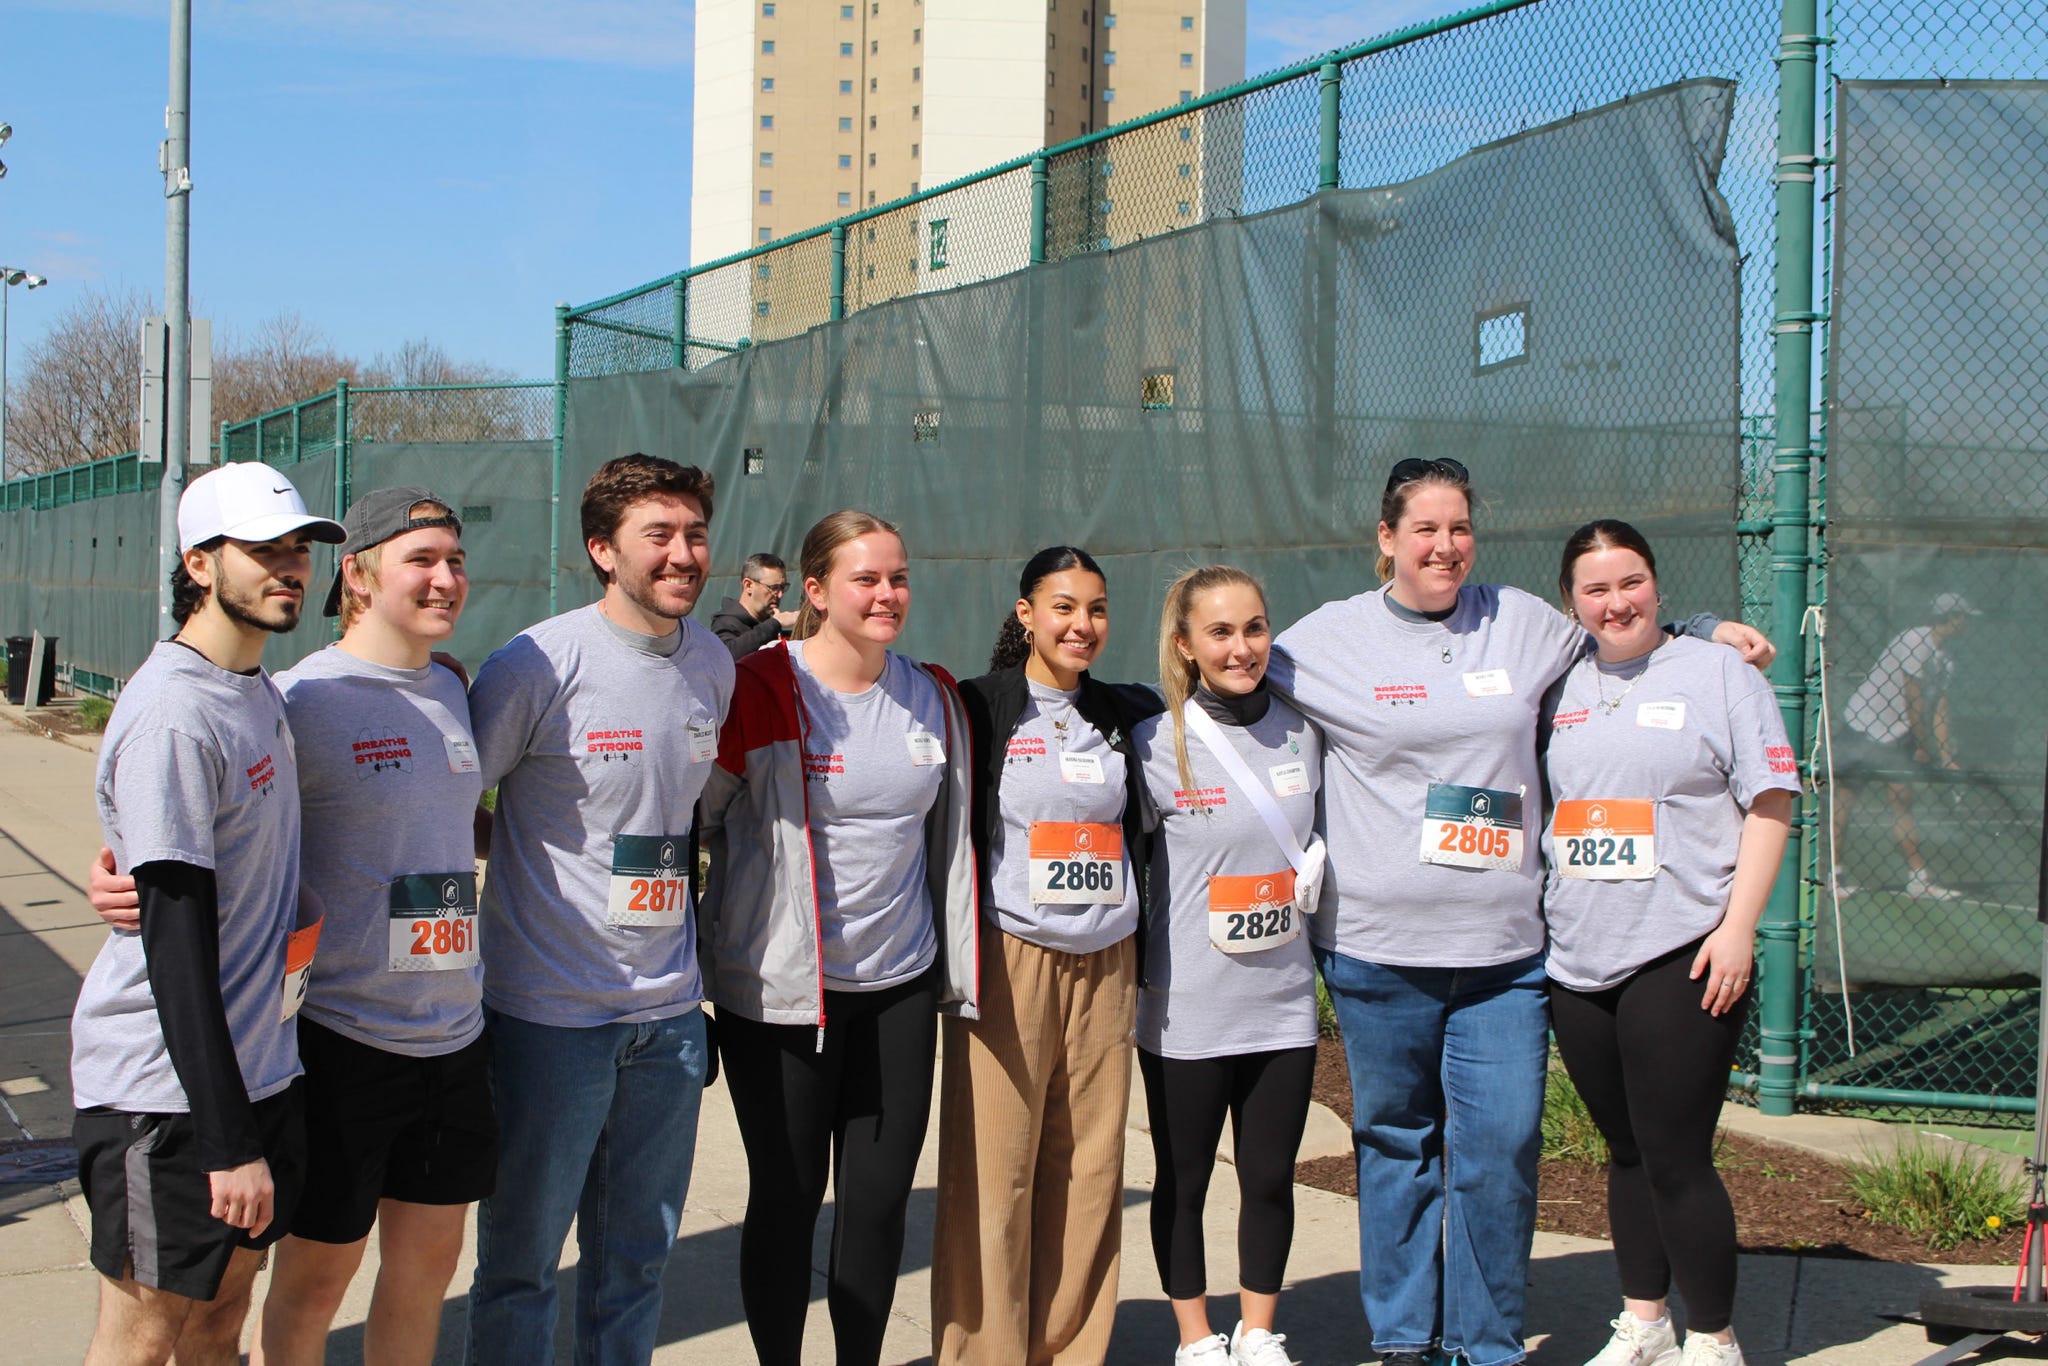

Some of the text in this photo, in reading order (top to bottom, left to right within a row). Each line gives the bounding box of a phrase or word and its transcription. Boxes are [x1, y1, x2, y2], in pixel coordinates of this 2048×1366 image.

[1375, 692, 1427, 701] STRONG
[586, 730, 642, 740] BREATHE
[1009, 737, 1045, 745] EATHE
[352, 738, 408, 752] BREATHE
[587, 742, 643, 752] STRONG
[354, 749, 412, 764] STRONG
[804, 764, 845, 773] TRONG
[1175, 797, 1226, 808] STONG
[1438, 823, 1510, 858] 2805
[1566, 837, 1637, 866] 2824
[1047, 861, 1114, 892] 2866
[628, 879, 684, 912] 2871
[1227, 905, 1291, 941] 2828
[410, 918, 474, 955] 2861
